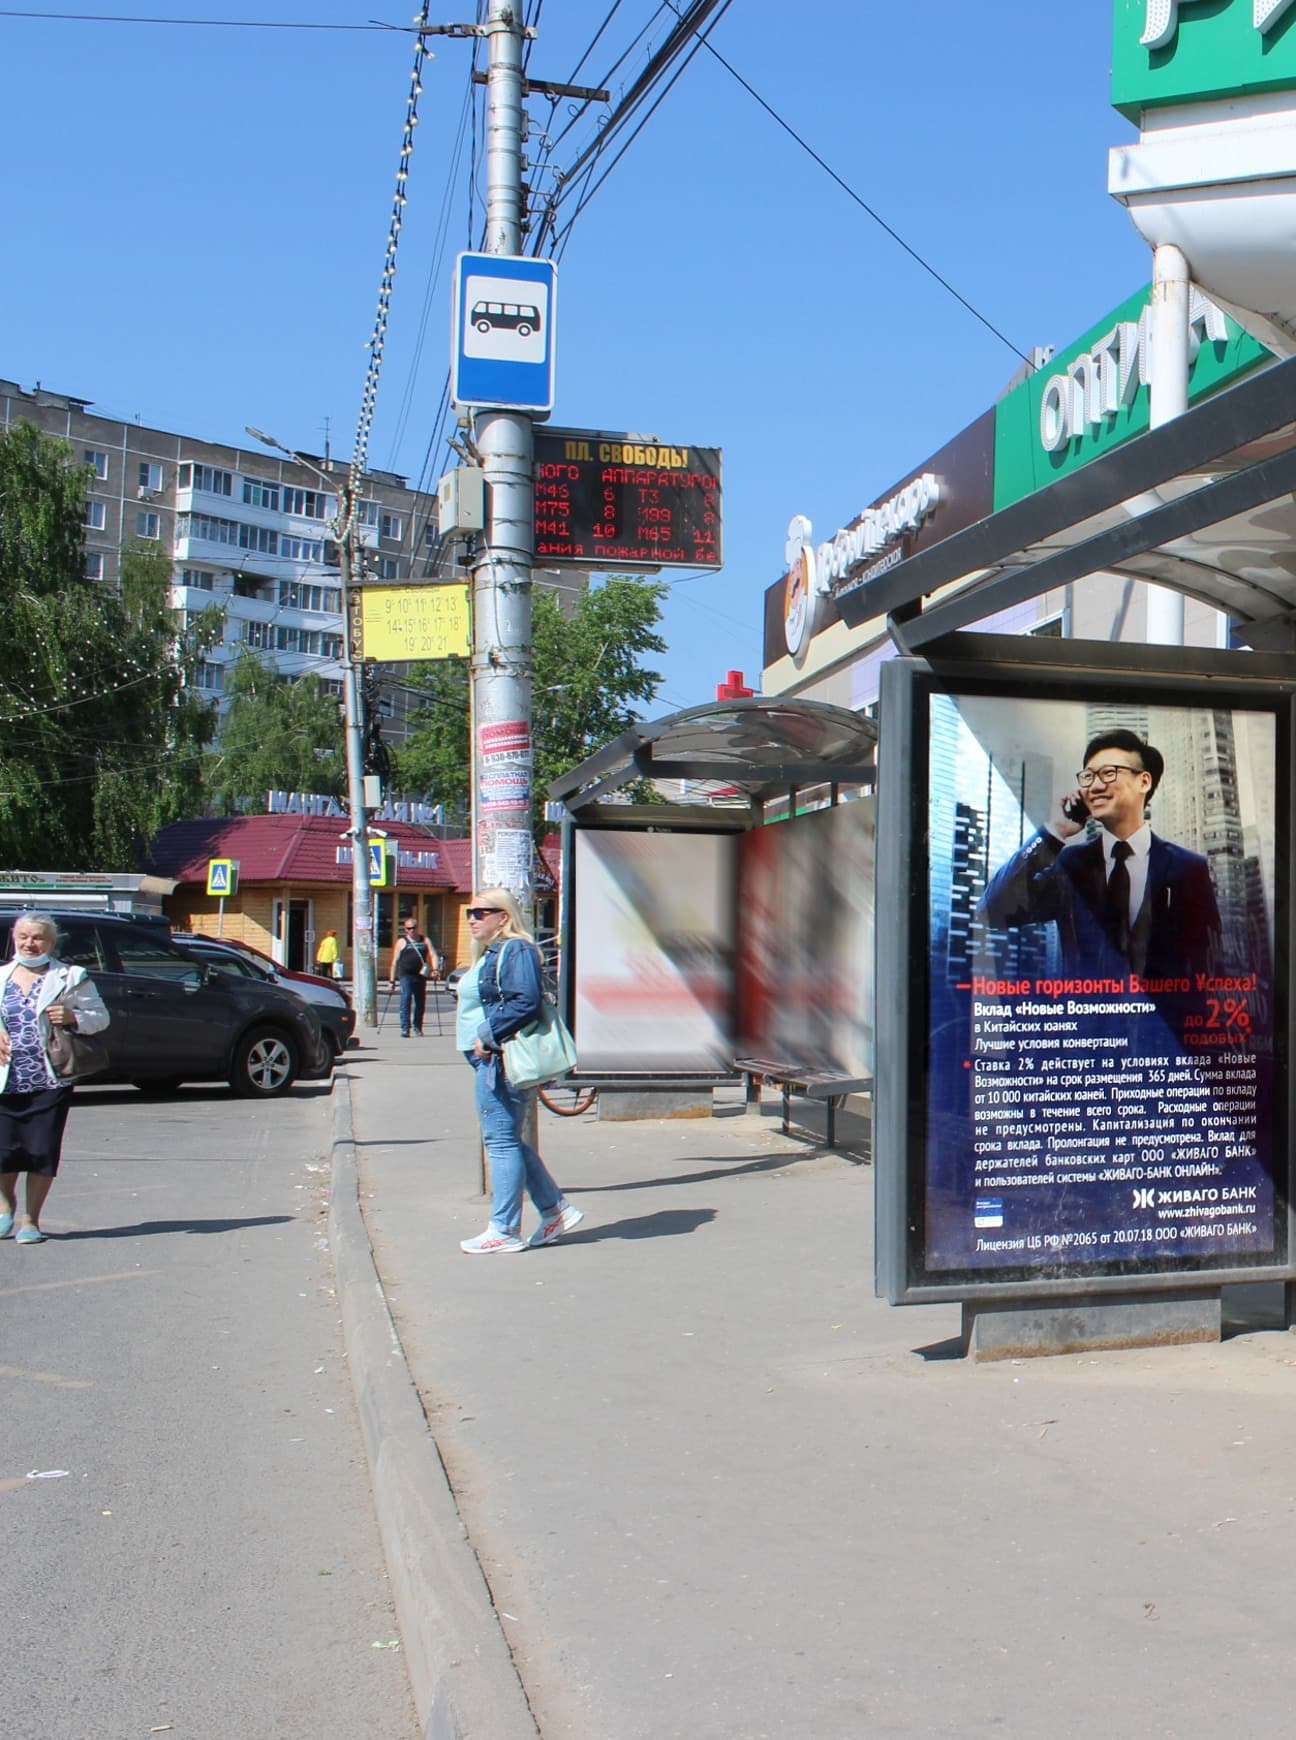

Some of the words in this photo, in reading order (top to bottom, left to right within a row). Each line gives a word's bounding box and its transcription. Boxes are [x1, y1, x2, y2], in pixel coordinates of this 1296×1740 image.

[1040, 281, 1228, 452] ОПТИА
[565, 441, 594, 461] ПЛ.
[599, 443, 688, 469] СВОБОДЫ
[973, 976, 1031, 995] Новые
[1036, 978, 1124, 999] горизонты
[1129, 974, 1190, 993] Вашего
[974, 1002, 1012, 1017] Вклад
[1016, 1001, 1064, 1015] «Новые
[1067, 1000, 1156, 1015] Возможности»
[1184, 1015, 1203, 1027] до
[1206, 999, 1249, 1028] 2%
[974, 1024, 981, 1033] в
[984, 1020, 1041, 1032] Китайских
[1044, 1021, 1078, 1031] юанях
[975, 1038, 1015, 1053] Лучшие
[1018, 1039, 1060, 1052] условия
[1063, 1037, 1128, 1050] конвертации
[974, 1059, 1011, 1071] Ставка
[1018, 1058, 1034, 1070] 2%
[1041, 1057, 1095, 1071] действует
[1102, 1058, 1114, 1068] на
[1121, 1056, 1169, 1070] условиях
[1176, 1055, 1211, 1067] вклада
[1218, 1052, 1256, 1064] «Новые
[975, 1075, 1043, 1088] Возможности»
[1047, 1076, 1058, 1085] на
[1060, 1075, 1082, 1088] срок
[1085, 1073, 1143, 1087] размещения
[1148, 1069, 1165, 1082] 365
[1168, 1069, 1192, 1083] дней.
[1194, 1068, 1223, 1083] Сумма
[1226, 1069, 1256, 1081] вклада
[974, 1095, 985, 1104] от
[988, 1091, 999, 1103] 10
[1002, 1090, 1020, 1103] 000
[1023, 1089, 1072, 1102] китайских
[1074, 1088, 1107, 1101] юаней.
[1111, 1087, 1164, 1102] Приходные
[1166, 1085, 1210, 1099] операции
[1213, 1085, 1223, 1095] по
[1226, 1085, 1257, 1097] вкладу
[974, 1108, 1023, 1121] возможны
[1030, 1108, 1036, 1117] в
[1042, 1107, 1081, 1117] течение
[1086, 1106, 1112, 1116] всего
[1117, 1105, 1147, 1117] срока.
[1158, 1101, 1207, 1115] Расходные
[1212, 1100, 1256, 1113] операции
[975, 1125, 988, 1136] не
[995, 1121, 1086, 1138] предусмотрены.
[1092, 1117, 1175, 1132] Капитализация
[1181, 1118, 1194, 1128] по
[1201, 1115, 1257, 1127] окончании
[974, 1141, 1002, 1154] срока
[1007, 1139, 1043, 1151] вклада.
[1047, 1135, 1110, 1151] Пролонгация
[1115, 1135, 1127, 1145] не
[1132, 1132, 1203, 1148] предусмотрена.
[1208, 1129, 1235, 1142] Вклад
[1239, 1130, 1256, 1141] для
[975, 1154, 1038, 1172] держателей
[1044, 1153, 1106, 1167] банковских
[1112, 1152, 1136, 1164] карт
[1141, 1149, 1164, 1162] ООО
[1171, 1146, 1219, 1160] «ЖИВАГО
[1225, 1144, 1256, 1158] БАНК»
[974, 1177, 981, 1187] и
[984, 1172, 1055, 1187] пользователей
[1057, 1172, 1096, 1184] системы
[1099, 1165, 1172, 1181] «ЖИВАГО-БАНК
[1174, 1162, 1222, 1178] ОНЛАЙН».
[1158, 1188, 1218, 1204] ЖИВАГО
[1222, 1186, 1257, 1200] БАНК
[1158, 1203, 1256, 1219] www.zhivagobank.ru
[976, 1238, 1025, 1252] Лицензия
[1027, 1235, 1042, 1250] ЦБ
[1044, 1234, 1059, 1247] РФ
[1100, 1234, 1111, 1244] от
[1113, 1228, 1153, 1243] 20.07.18
[1155, 1227, 1178, 1240] ООО
[1180, 1223, 1224, 1239] «ЖИВАГО
[1227, 1221, 1257, 1235] БАНК»
